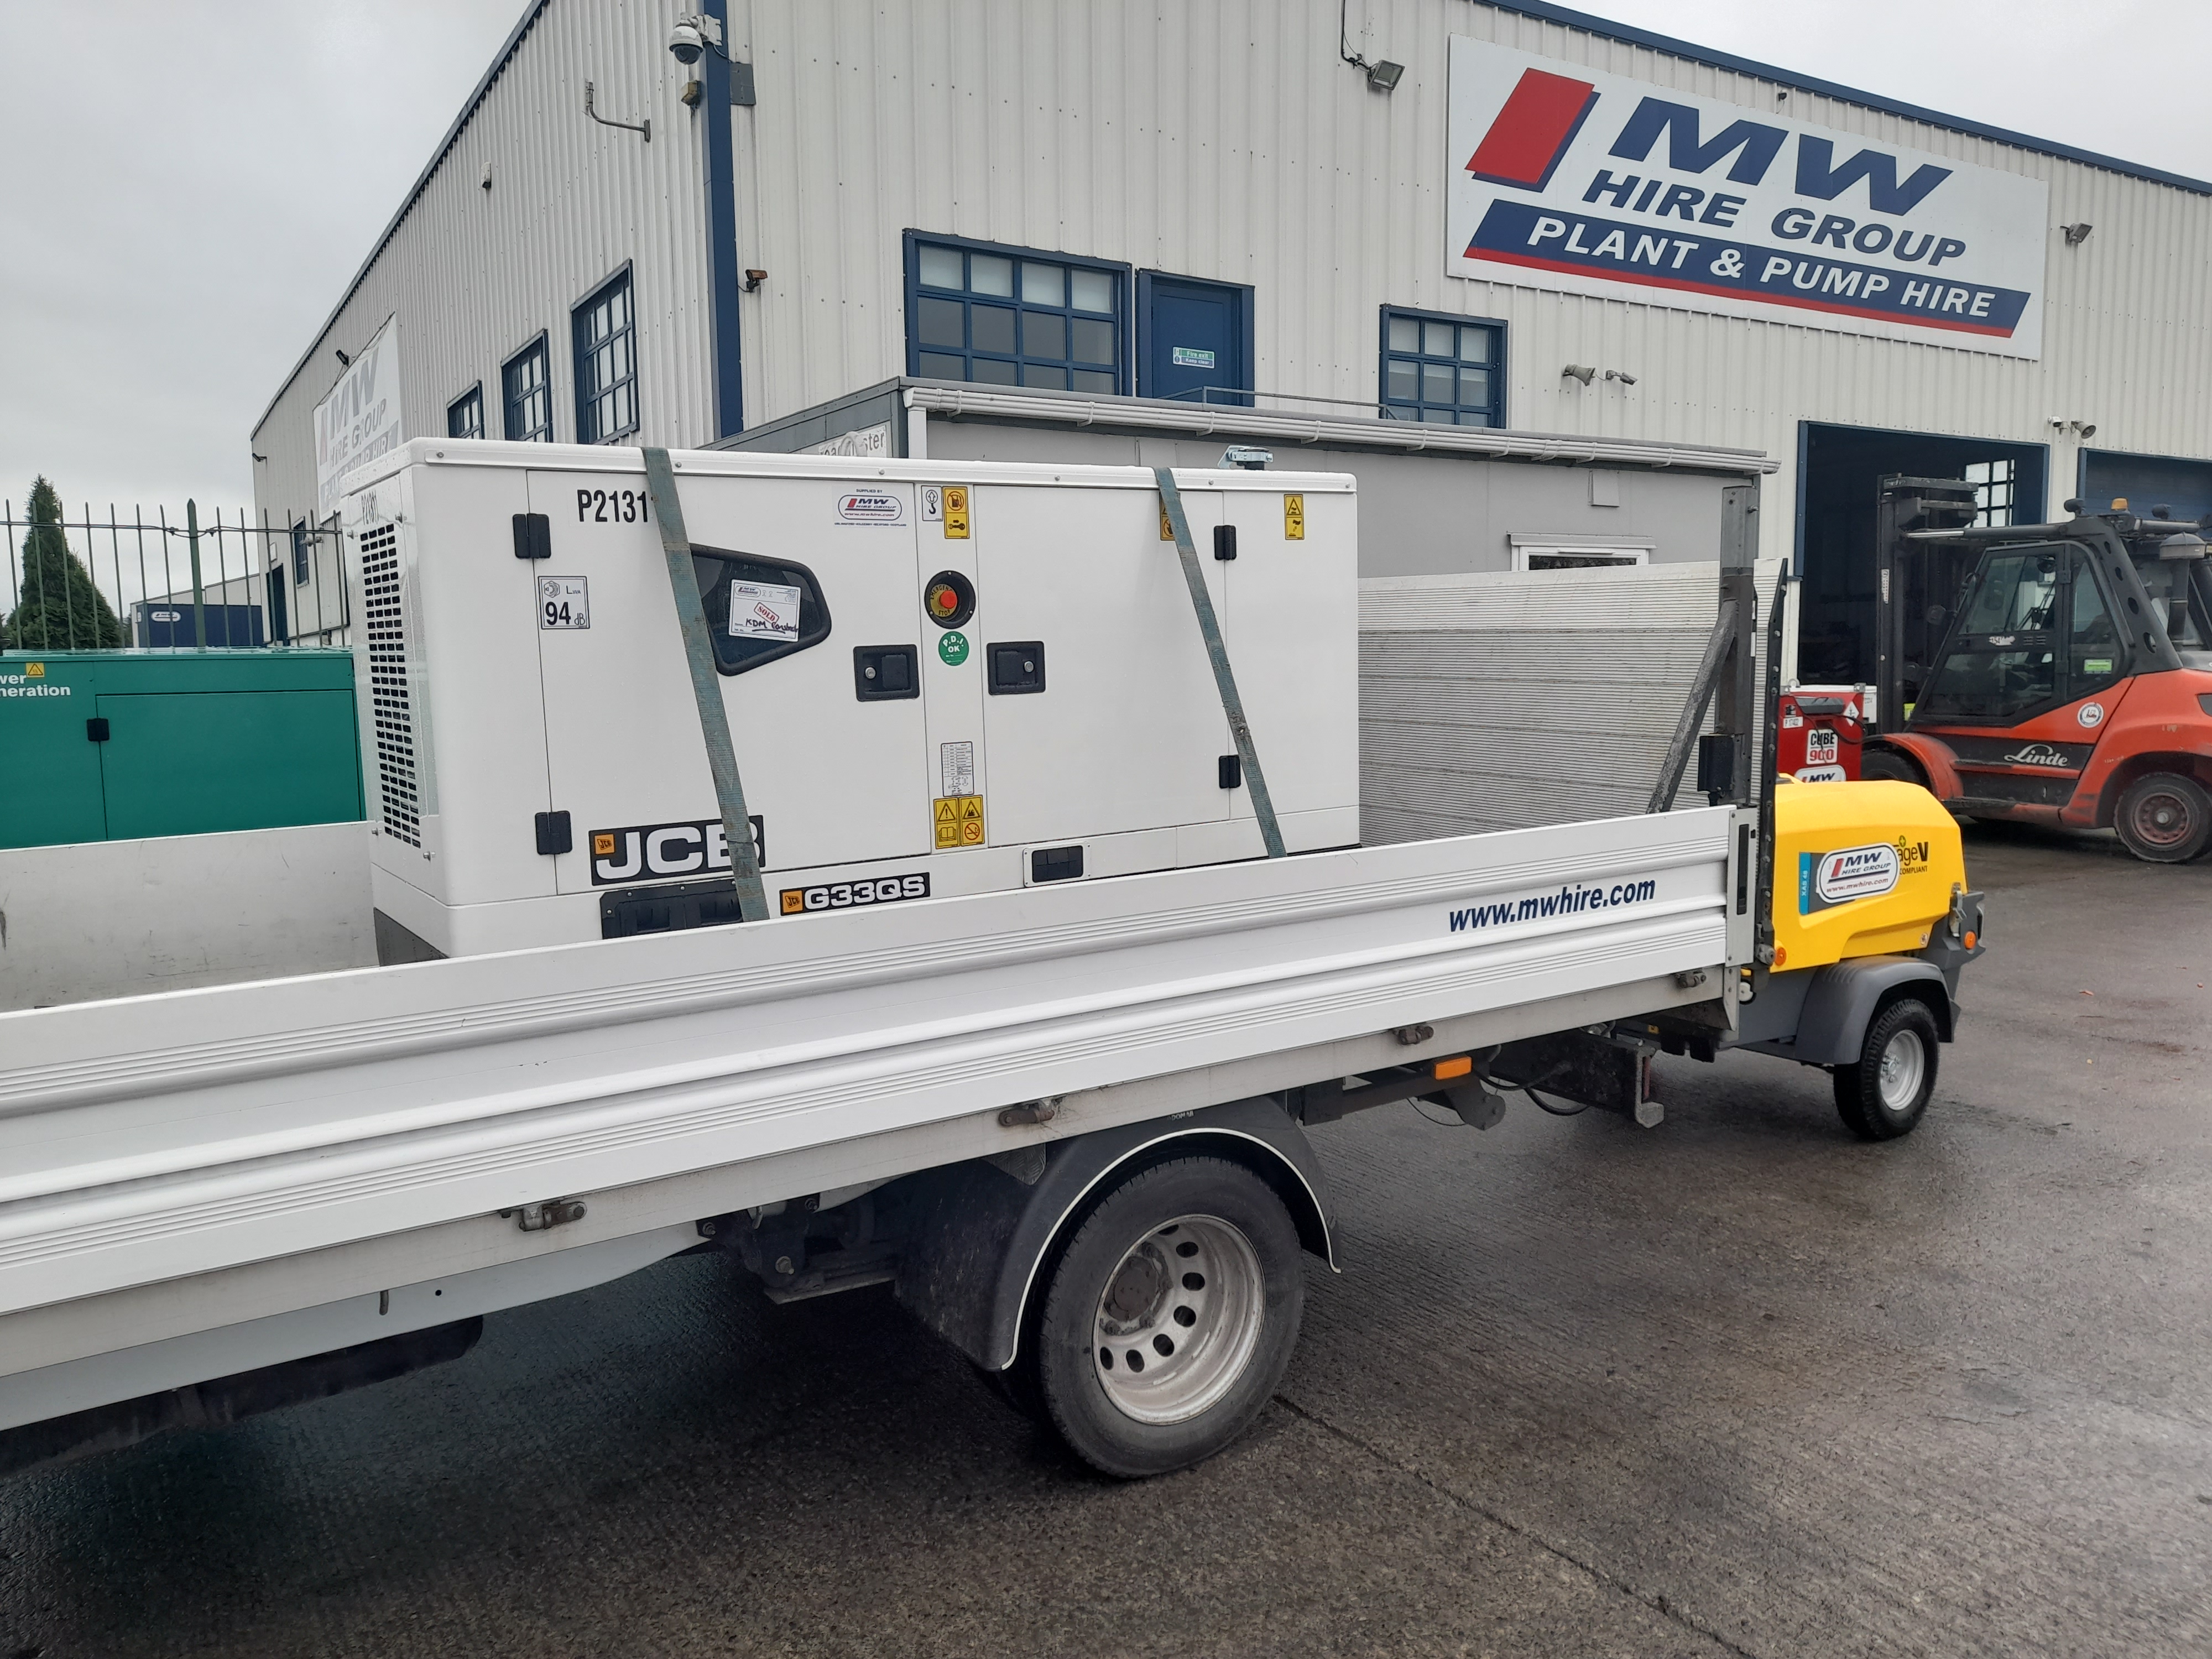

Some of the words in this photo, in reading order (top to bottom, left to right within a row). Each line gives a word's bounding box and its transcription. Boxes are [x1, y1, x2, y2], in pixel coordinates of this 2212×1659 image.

[1608, 96, 1954, 217] MW
[1582, 169, 1747, 228] HIRE
[1771, 207, 1966, 267] GROUP
[1526, 216, 1700, 270] PLANT
[1709, 248, 1745, 279] &
[1760, 256, 1890, 299] PUMP
[1900, 280, 1996, 318] HIRE
[330, 346, 379, 440] MW
[330, 435, 348, 469] HIRE
[352, 398, 387, 450] GROUP
[577, 489, 654, 523] P2131
[545, 602, 571, 625] 94
[574, 613, 586, 625] dB
[745, 618, 768, 629] KDM
[757, 606, 775, 622] SOLD
[1810, 732, 1835, 745] CUBE
[1809, 749, 1834, 761] 900
[2004, 743, 2068, 767] Linde
[1809, 773, 1836, 782] MW
[596, 822, 760, 880] JCB
[599, 839, 612, 849] JCB
[1845, 852, 1882, 867] MW
[1864, 862, 1891, 872] GROUP
[1899, 865, 1928, 875] COMPLIANT
[804, 875, 926, 910] G33QS
[1826, 877, 1889, 893] www.mwhire.com
[1449, 879, 1656, 932] www.mwhire.com
